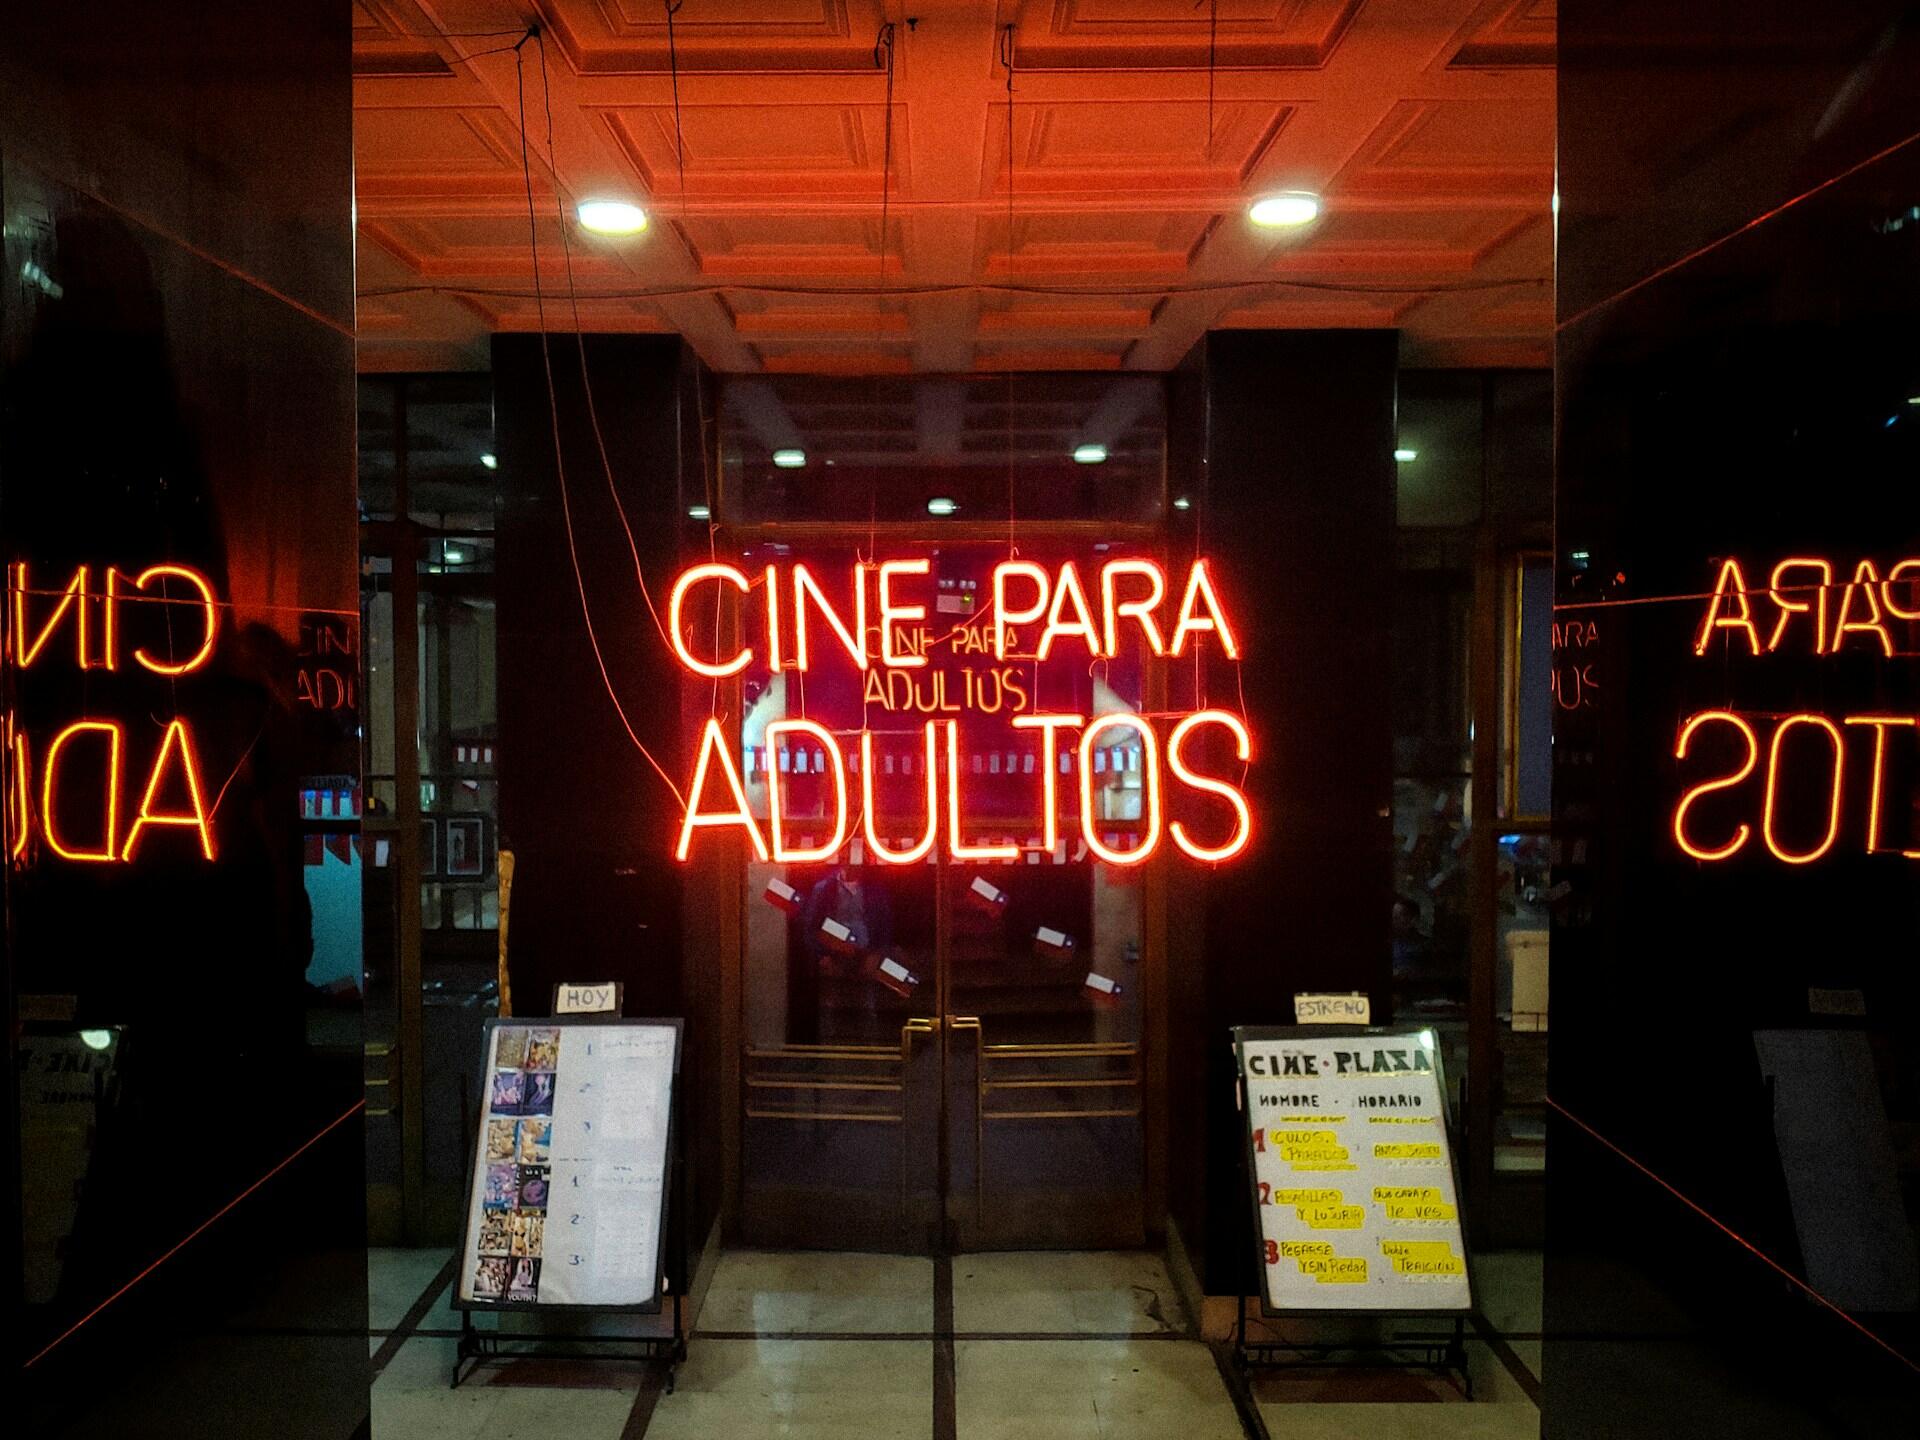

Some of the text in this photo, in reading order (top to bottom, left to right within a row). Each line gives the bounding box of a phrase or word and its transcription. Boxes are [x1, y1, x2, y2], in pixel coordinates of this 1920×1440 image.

[668, 558, 1238, 677] CINE PARA
[865, 668, 1027, 712] ADULTOS
[675, 711, 1252, 864] ADULTOS
[566, 988, 609, 1008] HOY
[1249, 1049, 1432, 1076] CINE PLAZA
[1259, 1094, 1422, 1108] NOMBRE HORARIO
[1258, 1182, 1272, 1205] 2
[1264, 1240, 1279, 1264] 3
